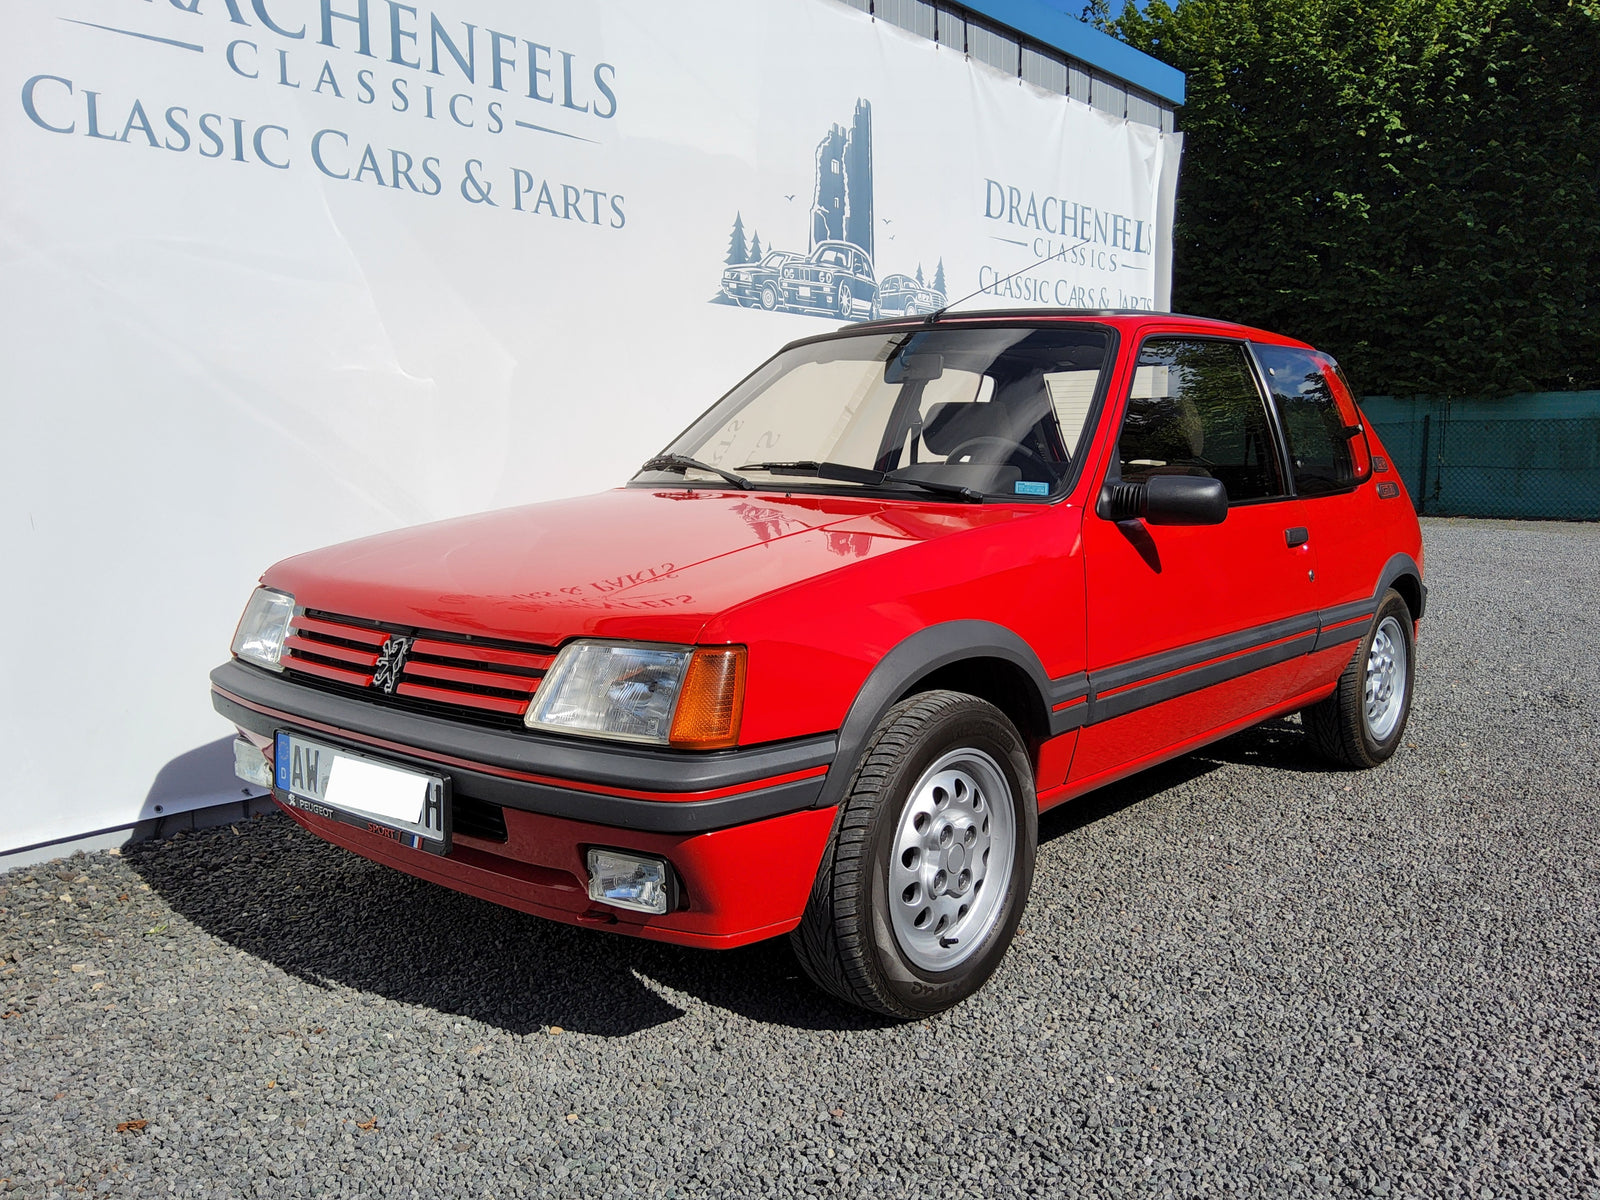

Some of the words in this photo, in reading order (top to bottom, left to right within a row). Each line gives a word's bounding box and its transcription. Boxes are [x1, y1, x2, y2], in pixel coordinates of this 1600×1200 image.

[226, 39, 505, 134] CLASSICS
[21, 74, 291, 170] CLASSIC
[310, 128, 443, 196] CARS
[460, 158, 500, 208] &
[509, 166, 627, 229] PARTS
[984, 178, 1153, 256] DRACHENFELS
[1033, 237, 1118, 272] CLASSICS
[979, 265, 1050, 304] CLASSIC
[280, 766, 287, 780] D
[291, 744, 320, 794] AW
[299, 799, 334, 819] PEUGEOT
[367, 822, 396, 839] SPORT
